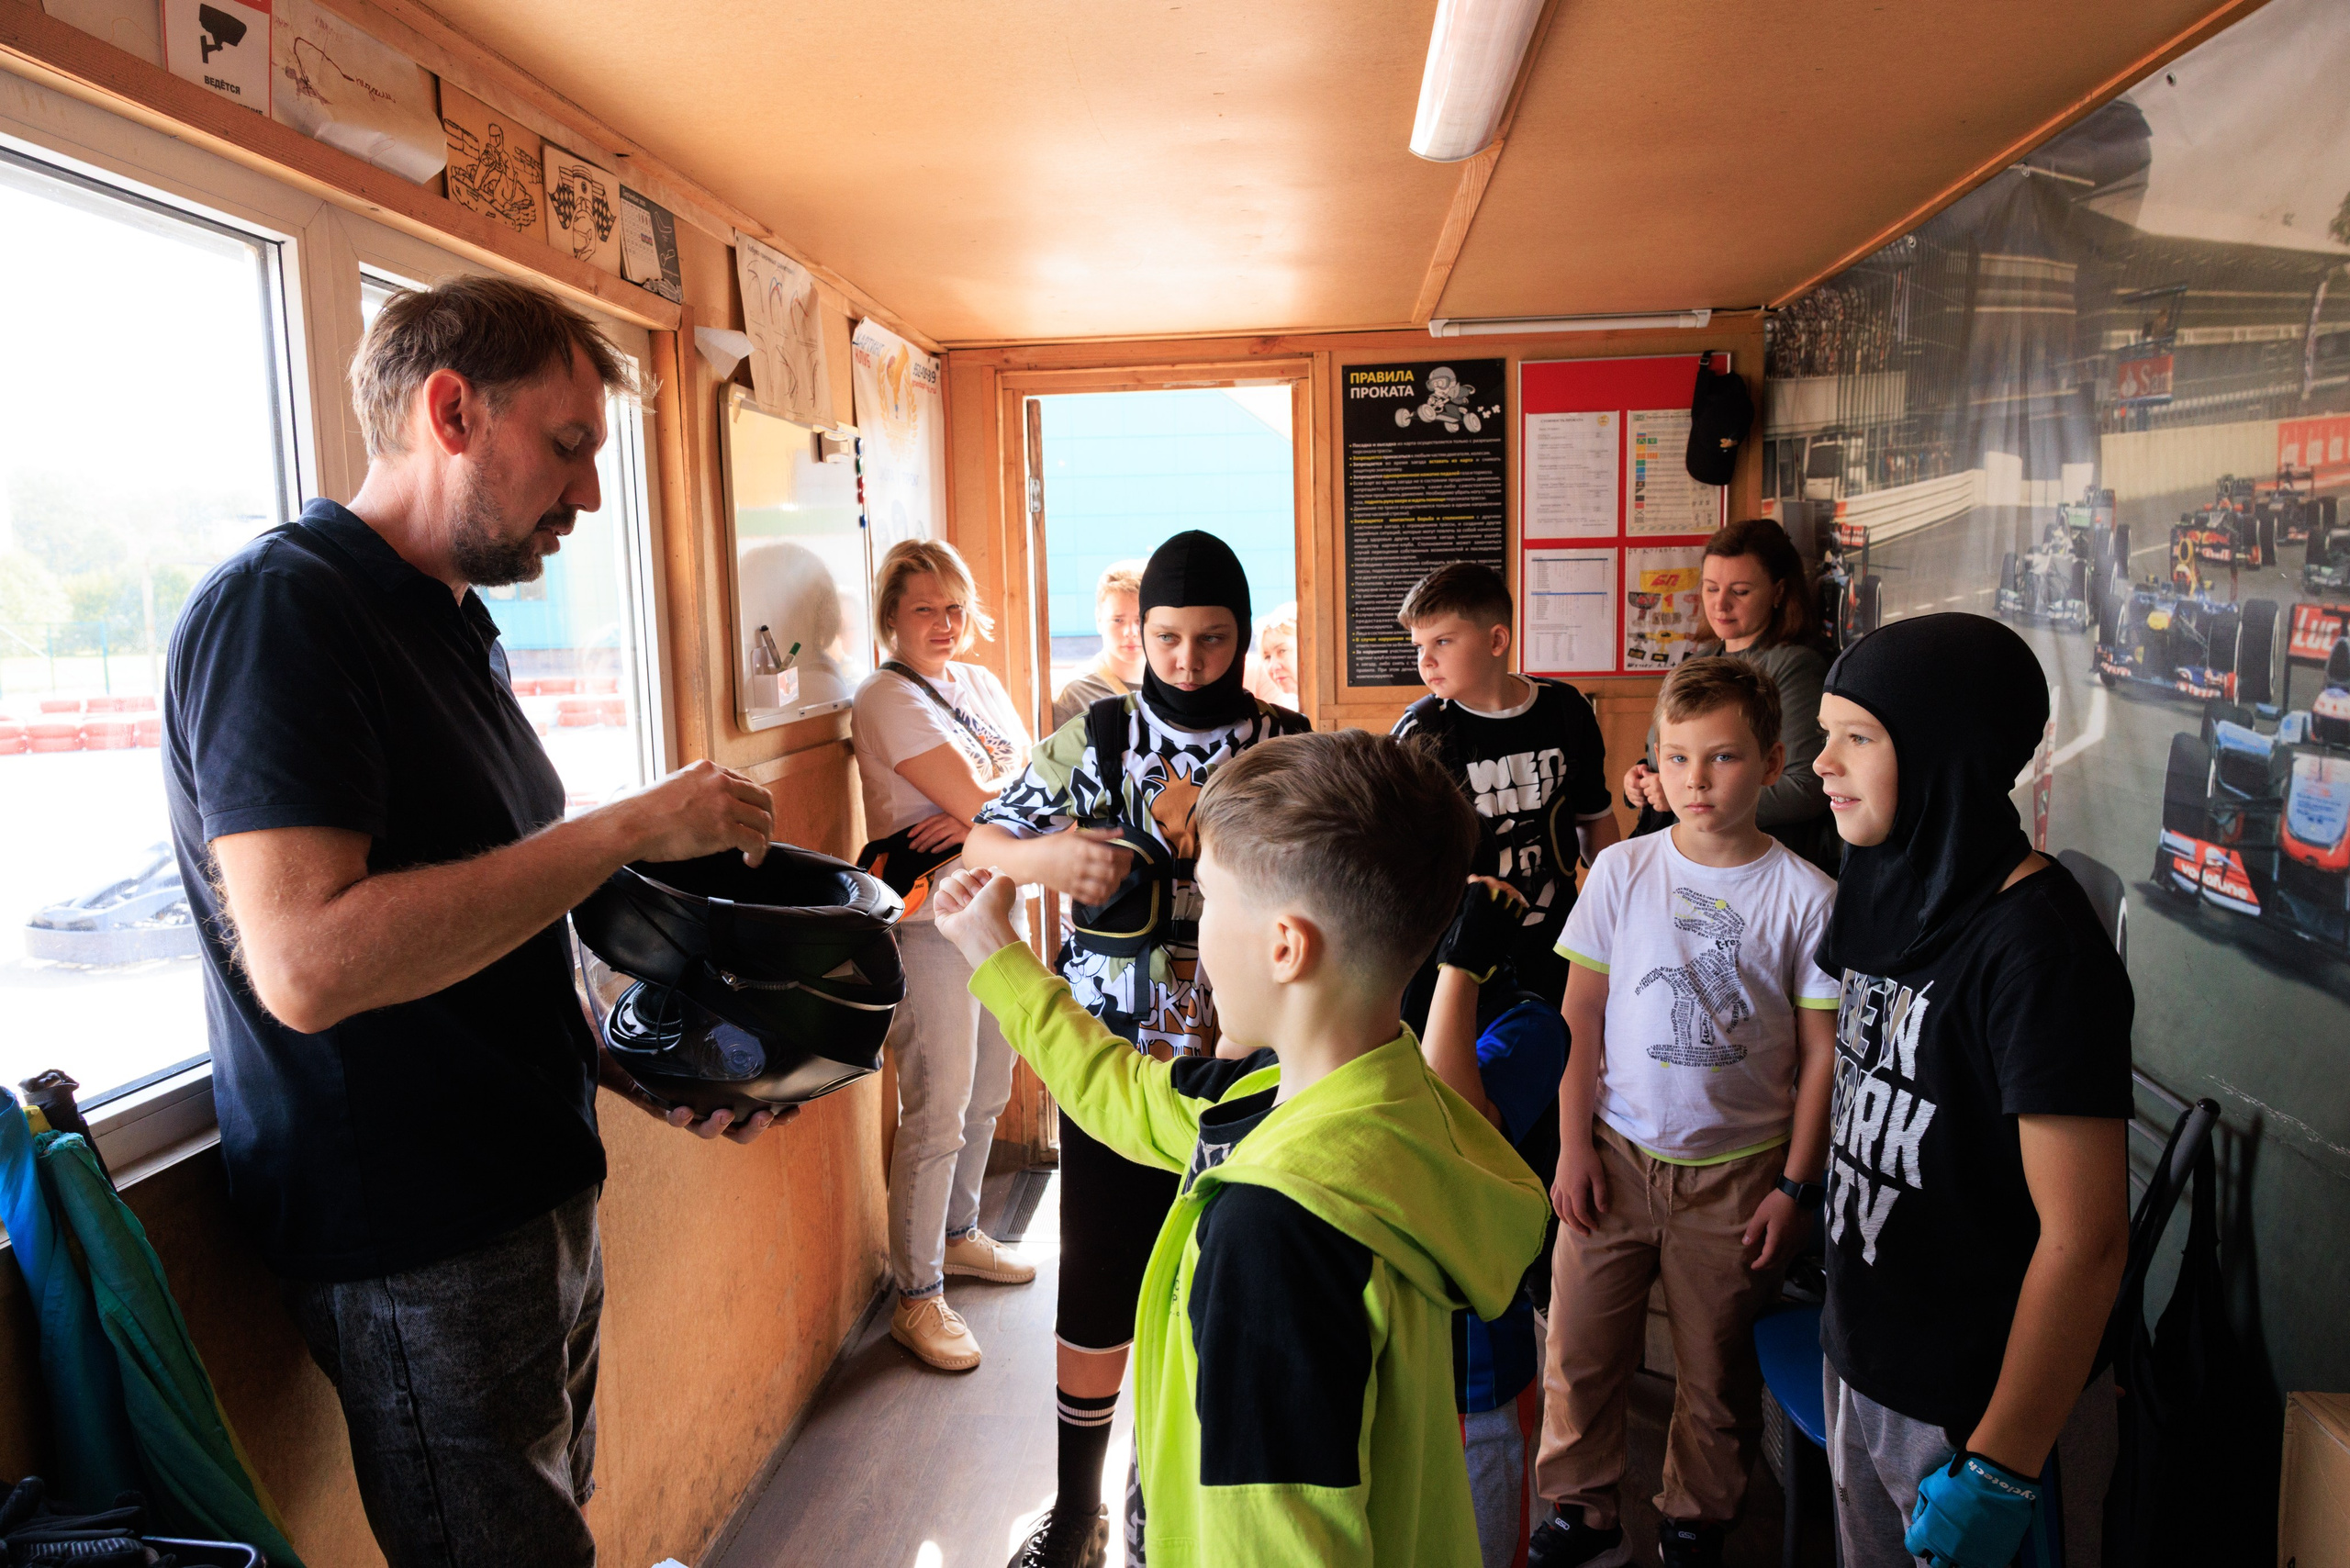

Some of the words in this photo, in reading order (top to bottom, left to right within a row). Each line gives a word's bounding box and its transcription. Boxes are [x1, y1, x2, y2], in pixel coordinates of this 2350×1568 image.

[204, 75, 241, 95] ВЕДЁТСЯ
[1350, 370, 1415, 384] ПРАВИЛА
[1350, 386, 1415, 398] ПРОКАТА
[1715, 939, 1740, 951] t-rex
[1968, 1461, 2036, 1501] cyclotech
